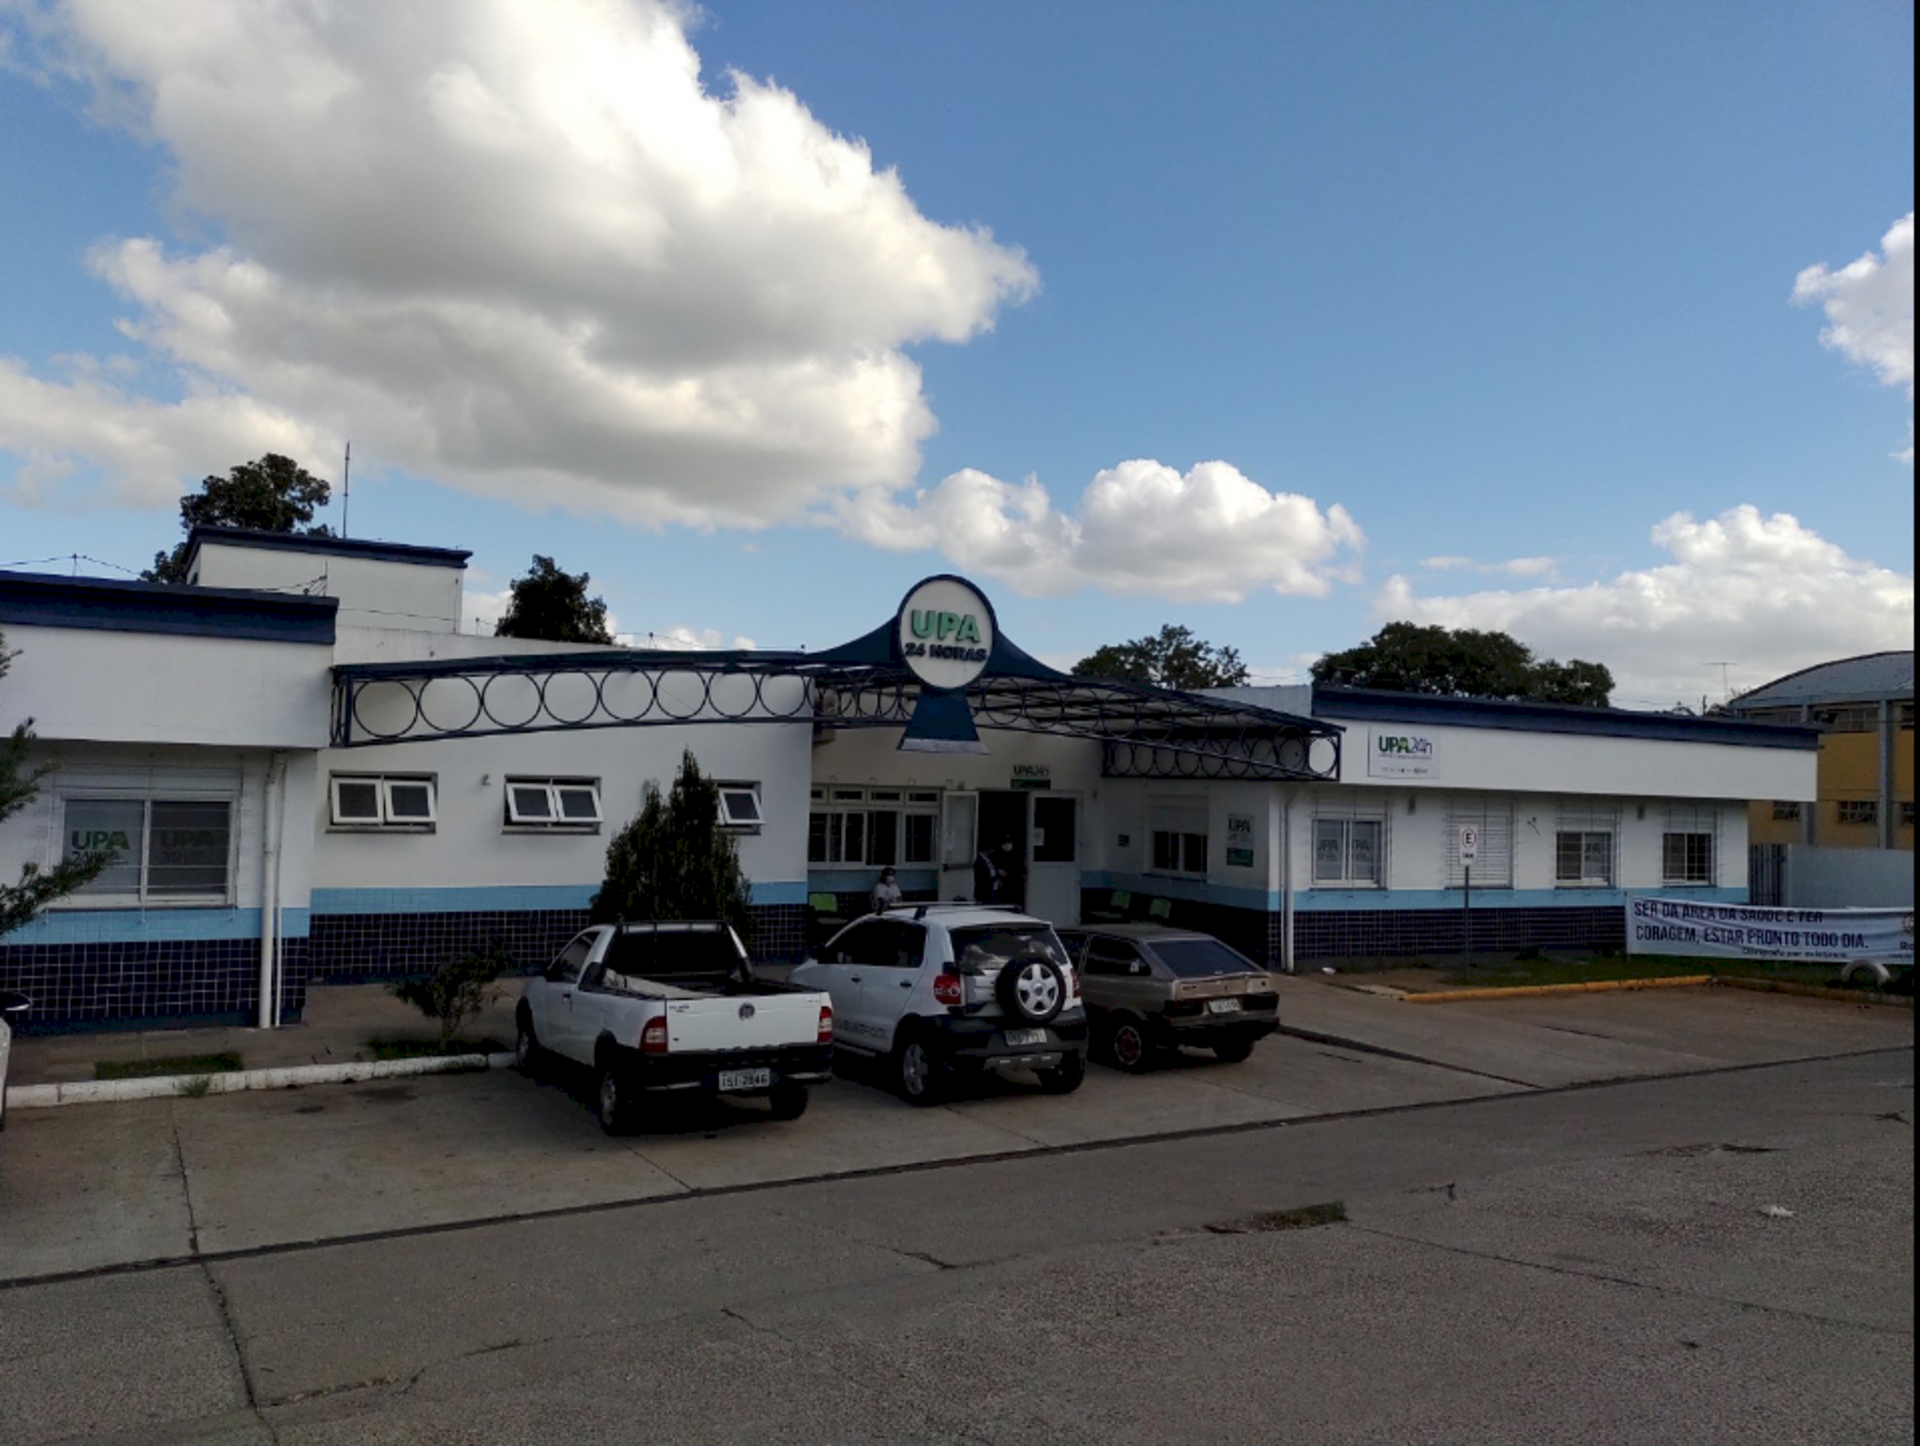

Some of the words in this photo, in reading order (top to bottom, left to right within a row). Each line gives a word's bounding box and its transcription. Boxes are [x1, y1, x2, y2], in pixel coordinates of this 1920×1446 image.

[911, 609, 980, 643] UPA
[905, 642, 926, 658] 24
[929, 644, 987, 663] HORAS
[72, 830, 130, 850] UPA
[161, 830, 215, 847] UPA
[1465, 832, 1473, 844] E
[1634, 902, 1657, 917] SER
[1662, 903, 1678, 919] DA
[1636, 925, 1700, 944] CORAGEM,
[1704, 927, 1744, 944] ESTAR
[1747, 929, 1799, 947] PRONTO
[1804, 931, 1839, 948] TODO
[1842, 933, 1869, 949] DIA.
